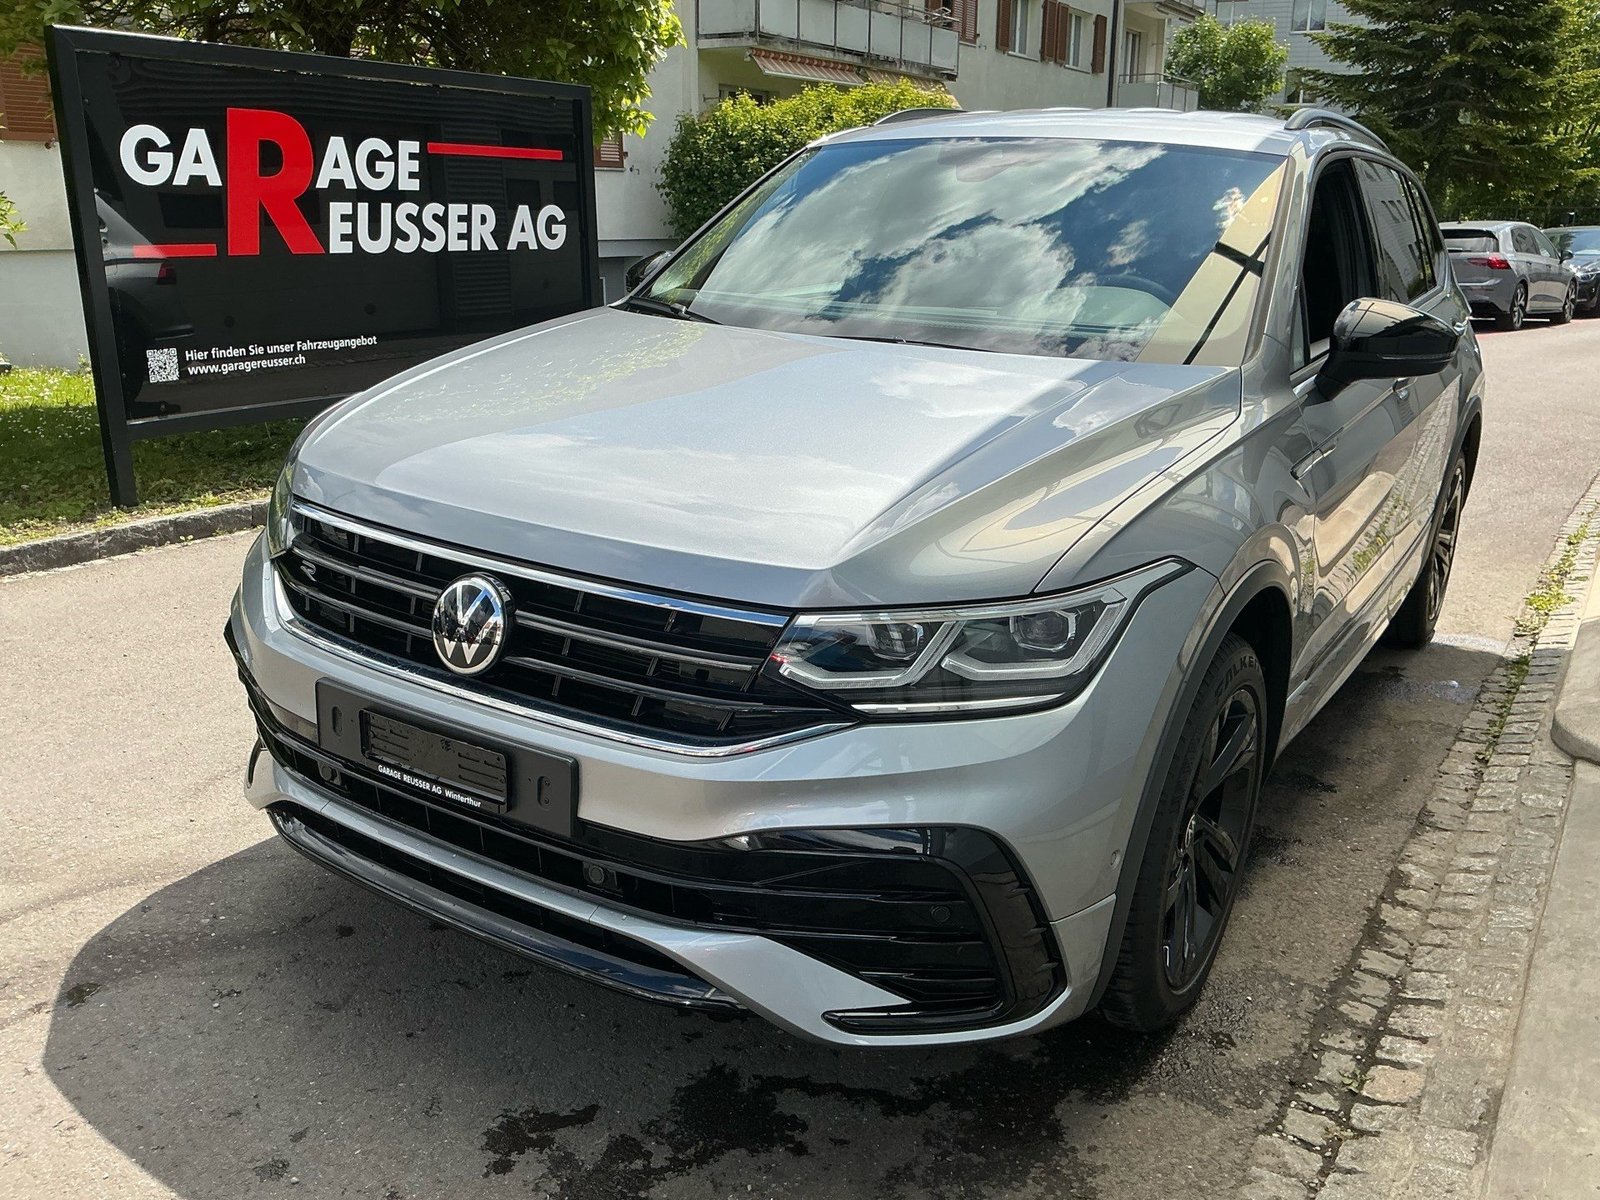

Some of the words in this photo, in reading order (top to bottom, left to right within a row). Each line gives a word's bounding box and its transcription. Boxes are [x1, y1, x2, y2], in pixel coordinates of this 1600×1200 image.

[119, 107, 421, 255] GARAGE
[508, 205, 567, 251] AG
[185, 349, 209, 361] Hier
[211, 346, 247, 359] finden
[248, 344, 265, 356] Sie
[266, 343, 295, 354] unser
[296, 335, 378, 350] Fahrzeugangebot
[187, 354, 306, 376] www.garagereusser.ch
[377, 764, 402, 780] GARAGE
[403, 774, 431, 791] REUSSER
[431, 785, 442, 795] AG
[444, 789, 482, 808] Winterthur
